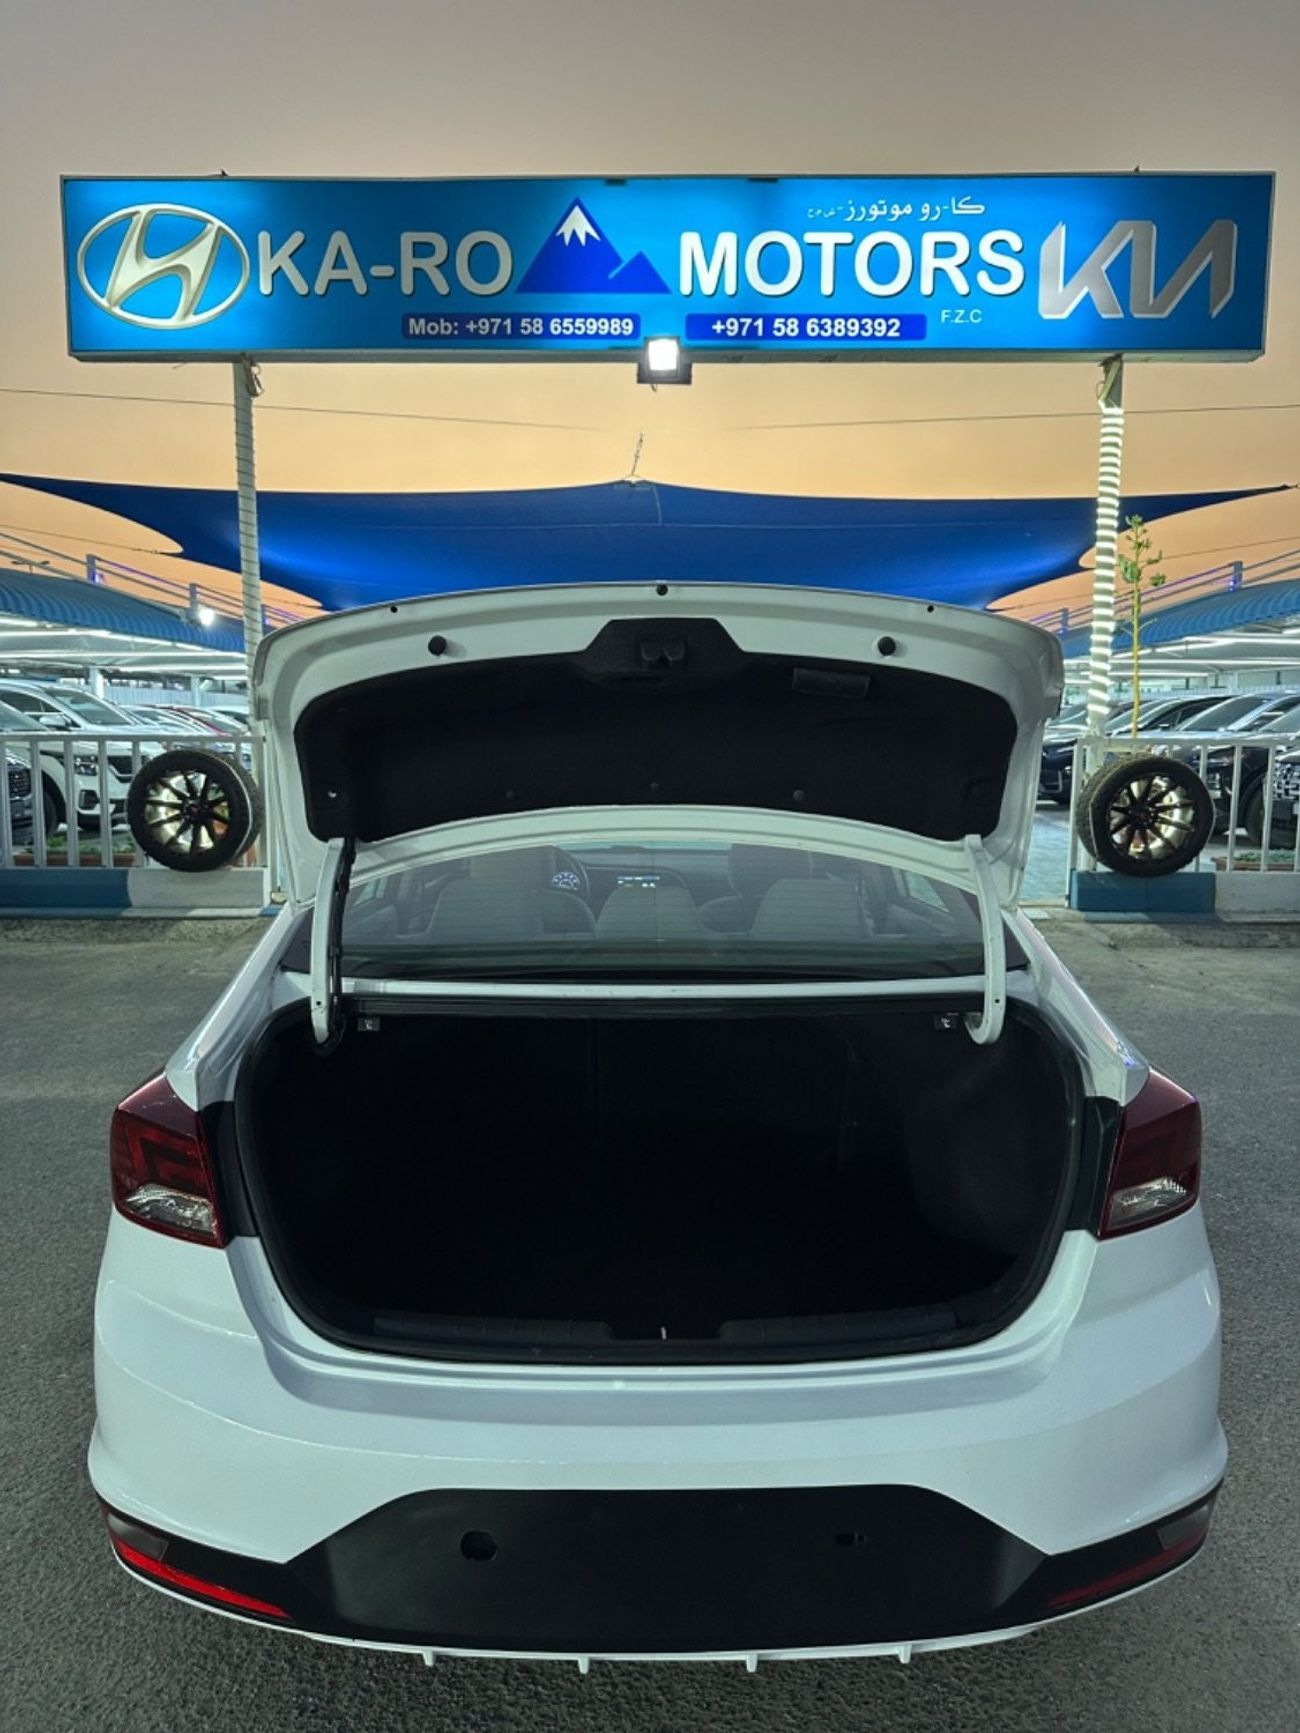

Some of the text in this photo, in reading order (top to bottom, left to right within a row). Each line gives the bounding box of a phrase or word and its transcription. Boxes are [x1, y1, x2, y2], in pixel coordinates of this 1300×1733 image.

[257, 230, 1026, 296] KA-RO MOTORS
[408, 318, 634, 335] Mob: +971 58 6559989
[711, 317, 901, 337] +971 58 6389392
